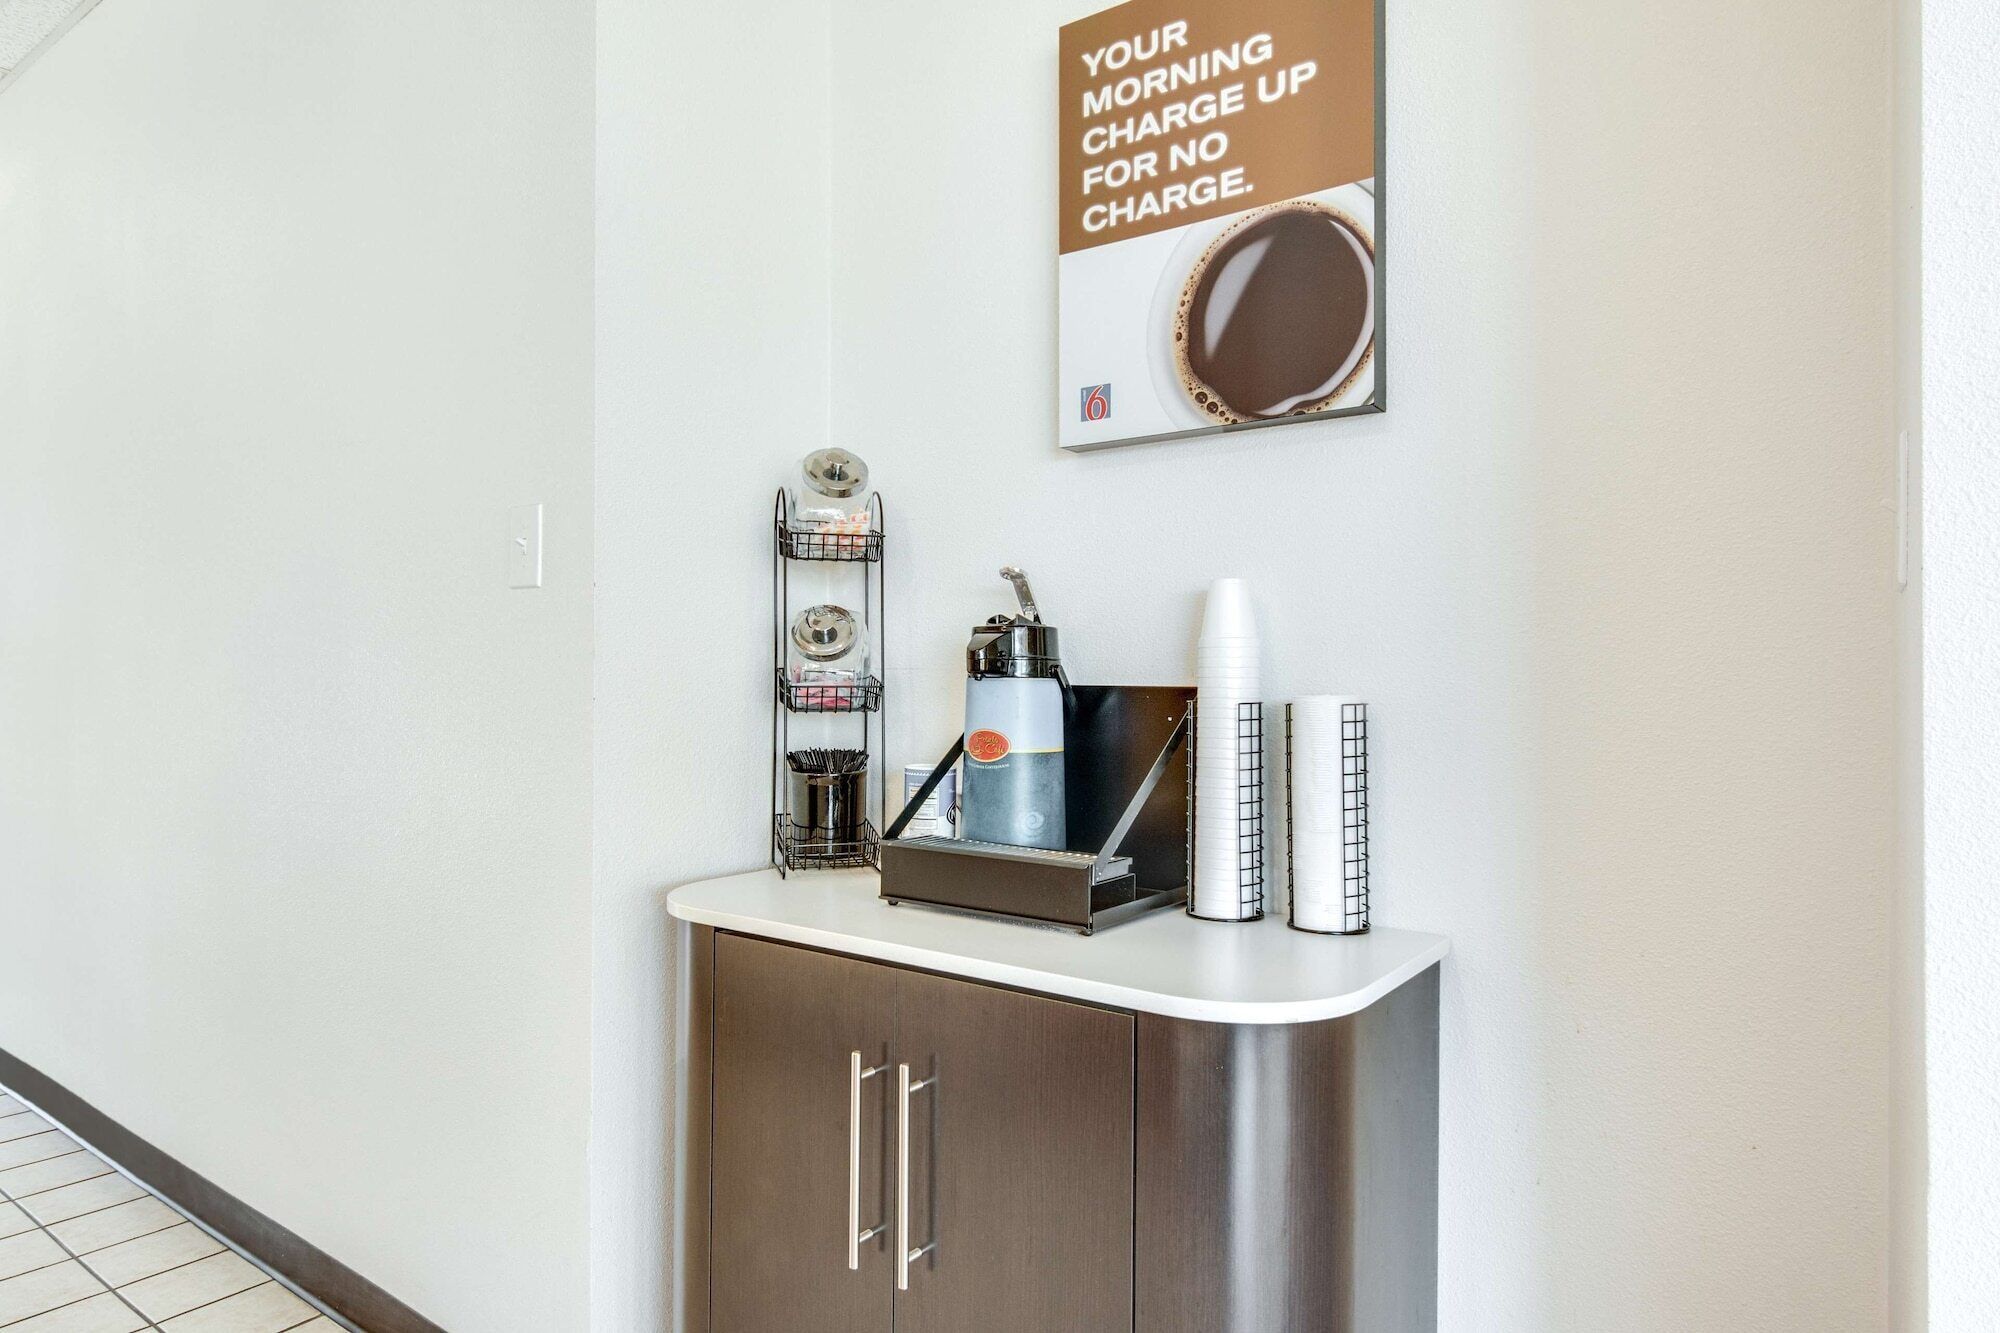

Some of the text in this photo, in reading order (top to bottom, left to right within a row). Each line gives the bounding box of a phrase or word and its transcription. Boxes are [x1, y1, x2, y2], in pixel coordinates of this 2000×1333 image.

[1082, 20, 1188, 77] YOUR
[1082, 33, 1274, 118] MORNING
[1082, 61, 1317, 156] CHARGE UP
[1083, 131, 1228, 194] FOR NO
[1082, 167, 1254, 233] CHARGE.
[1086, 384, 1108, 422] 6
